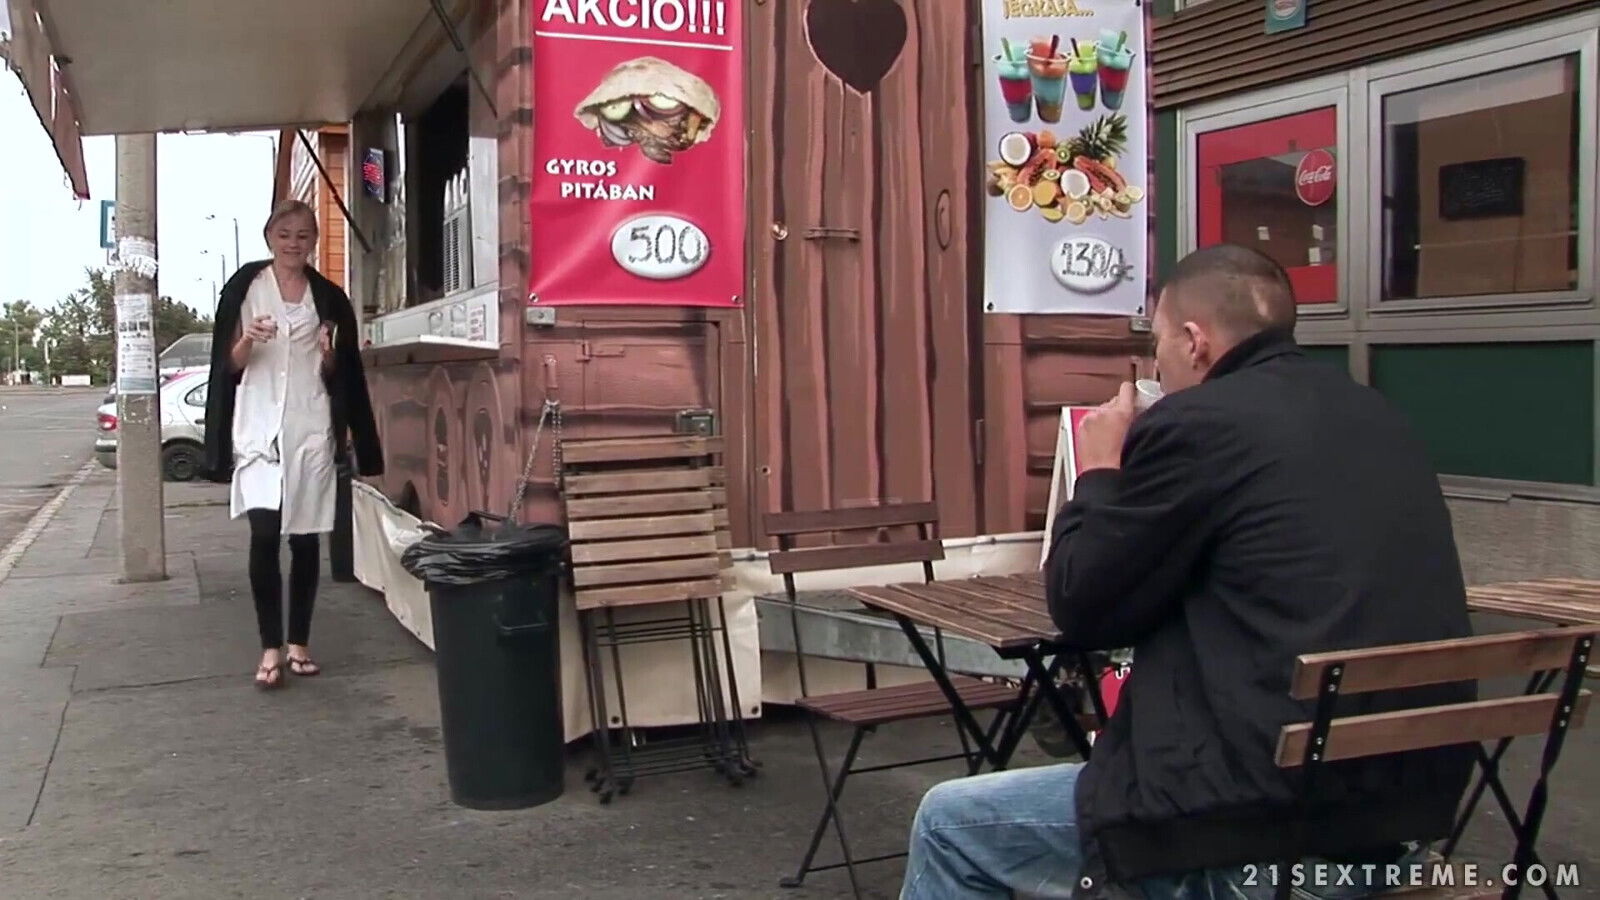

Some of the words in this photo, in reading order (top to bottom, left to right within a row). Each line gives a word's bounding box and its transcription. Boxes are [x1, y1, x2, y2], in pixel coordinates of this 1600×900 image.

[545, 158, 617, 177] GYROS
[561, 179, 655, 201] PITÁBAN
[628, 224, 703, 265] 500
